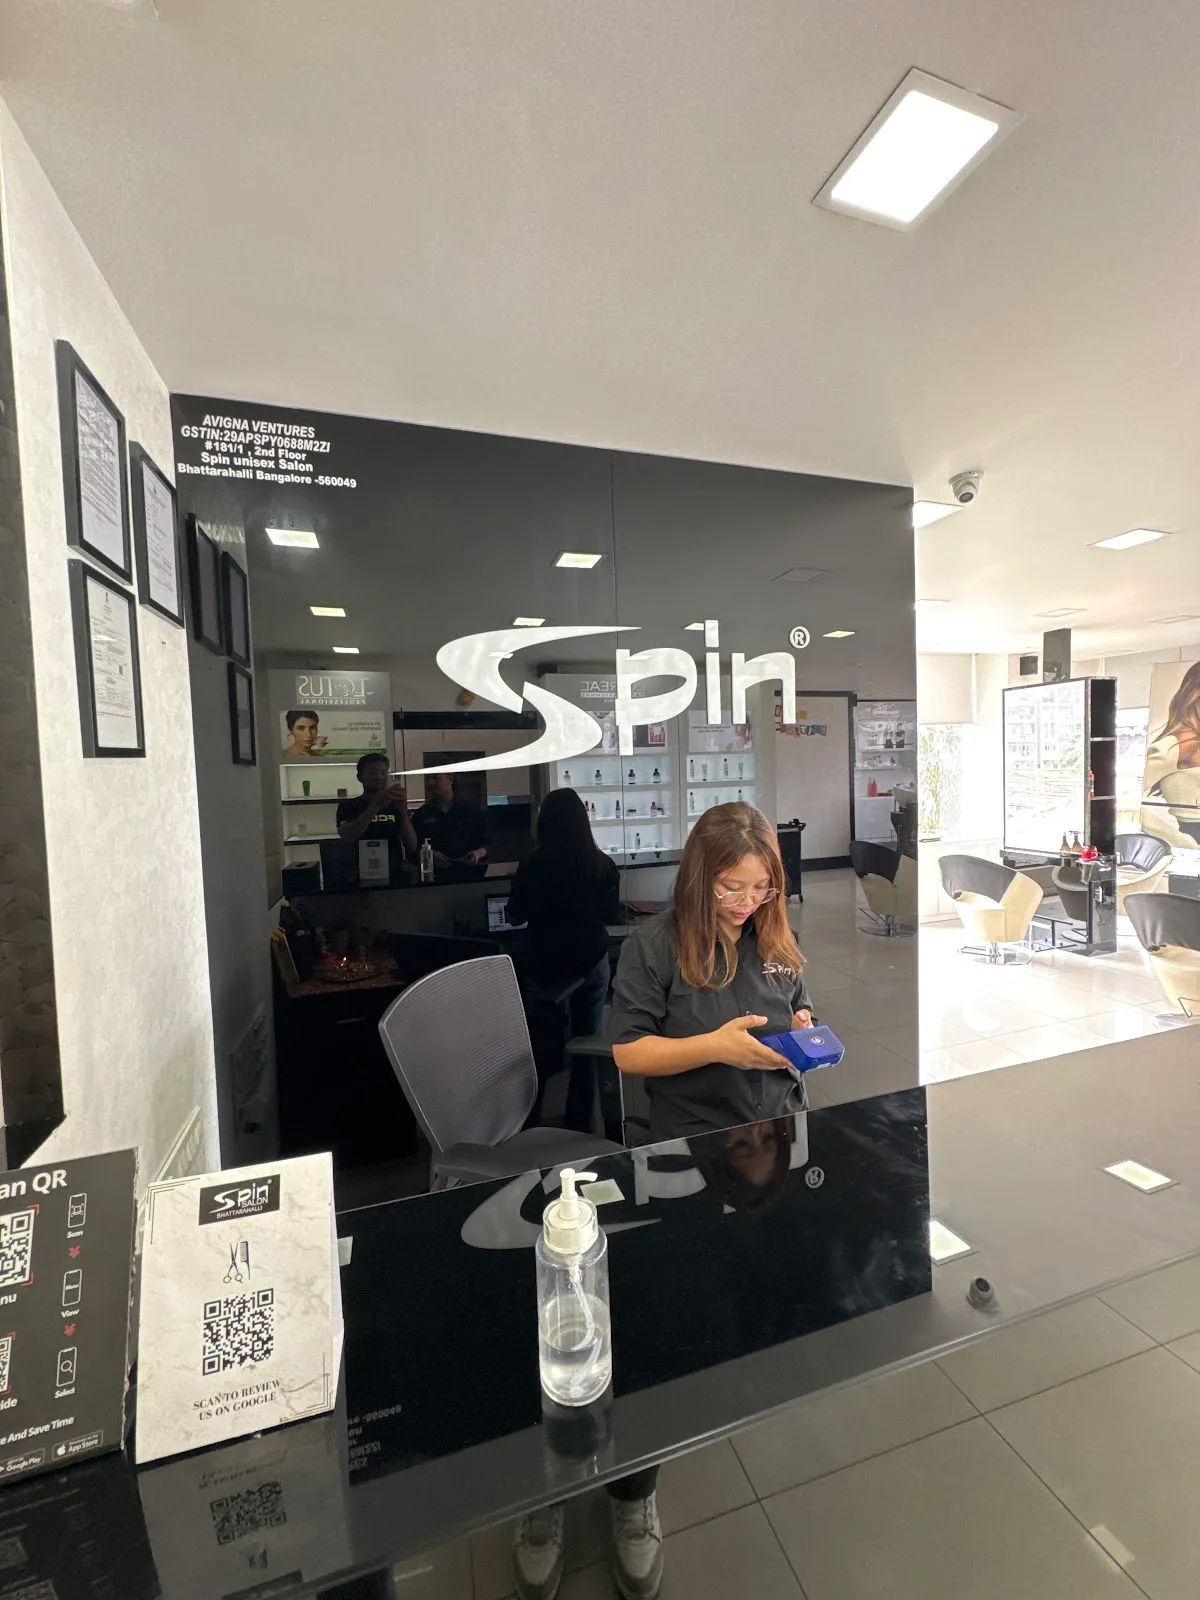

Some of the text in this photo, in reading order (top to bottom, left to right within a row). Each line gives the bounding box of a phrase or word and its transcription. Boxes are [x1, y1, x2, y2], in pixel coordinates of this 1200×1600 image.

[202, 414, 315, 438] AVIGNA VENTURES
[205, 441, 243, 454] #181/1
[254, 447, 275, 458] 2nd
[278, 449, 306, 461] Floor
[201, 452, 313, 472] Spin unisex Salon
[177, 463, 357, 488] Bhattarahalli Bangalore -560049
[32, 1169, 67, 1194] QR
[209, 1182, 269, 1214] Spin
[241, 1197, 269, 1208] SALON
[216, 1205, 263, 1219] BHATTARAHALLI
[66, 1230, 84, 1239] Scan
[61, 1309, 80, 1318] View
[54, 1387, 76, 1399] Select
[193, 1379, 281, 1411] SCAN TO REVIEW
[199, 1391, 277, 1421] US ON GOOGLE
[7, 1428, 27, 1443] And
[28, 1423, 50, 1437] Save
[51, 1416, 75, 1430] Time
[68, 1444, 82, 1453] App
[81, 1438, 99, 1450] Store
[6, 1460, 29, 1472] Google
[29, 1457, 42, 1465] Play
